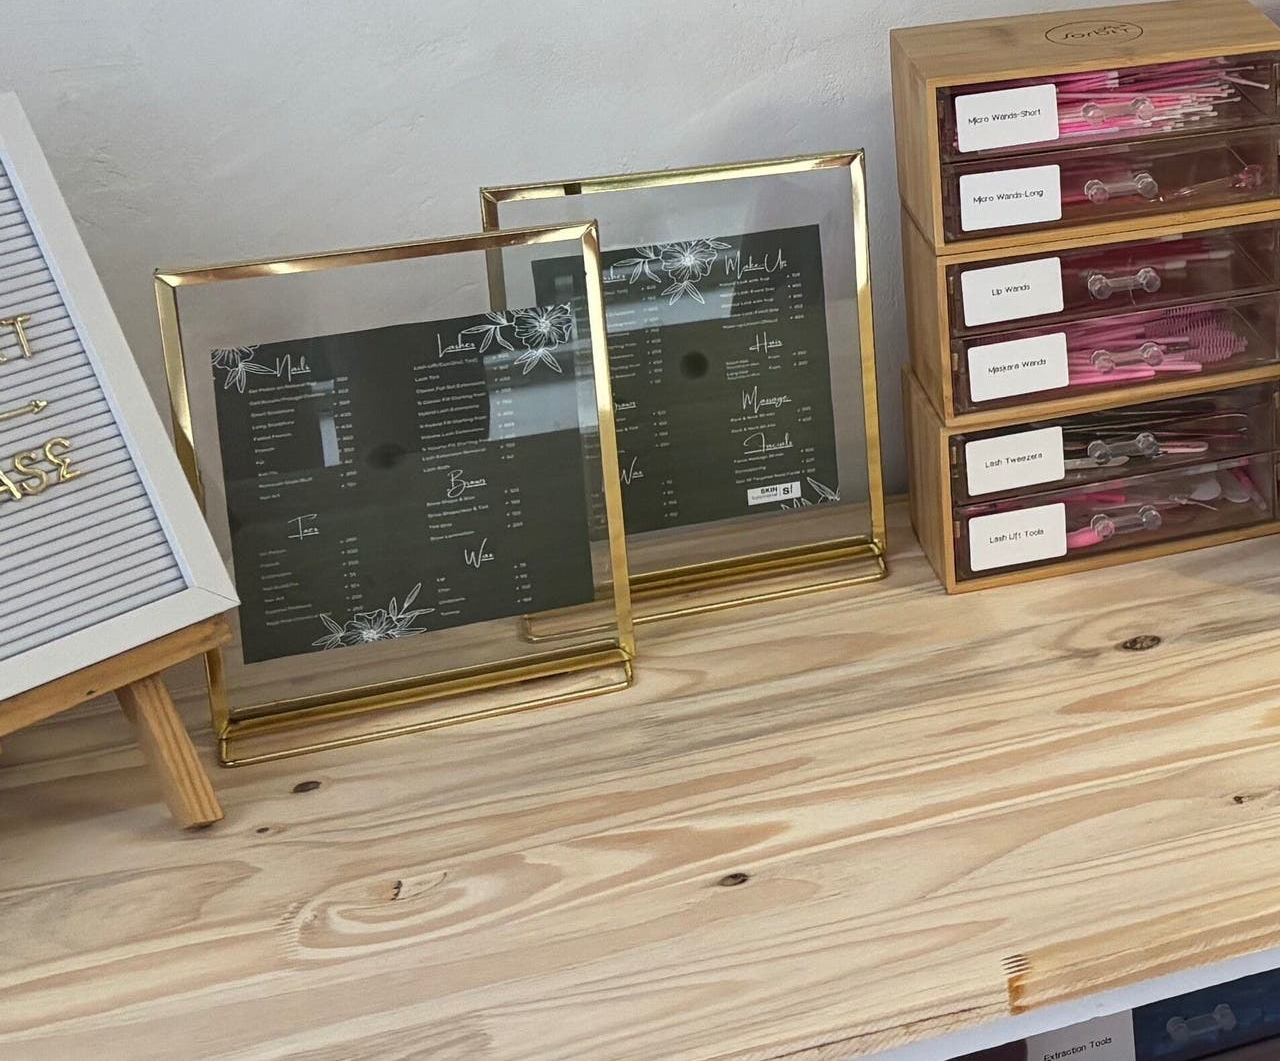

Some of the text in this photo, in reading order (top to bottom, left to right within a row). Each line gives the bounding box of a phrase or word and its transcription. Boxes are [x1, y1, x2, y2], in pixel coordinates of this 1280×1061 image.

[437, 332, 477, 358] Lashes
[275, 354, 312, 382] Nails
[760, 486, 778, 495] SKIN
[1043, 1036, 1112, 1061] Extraction Tools
